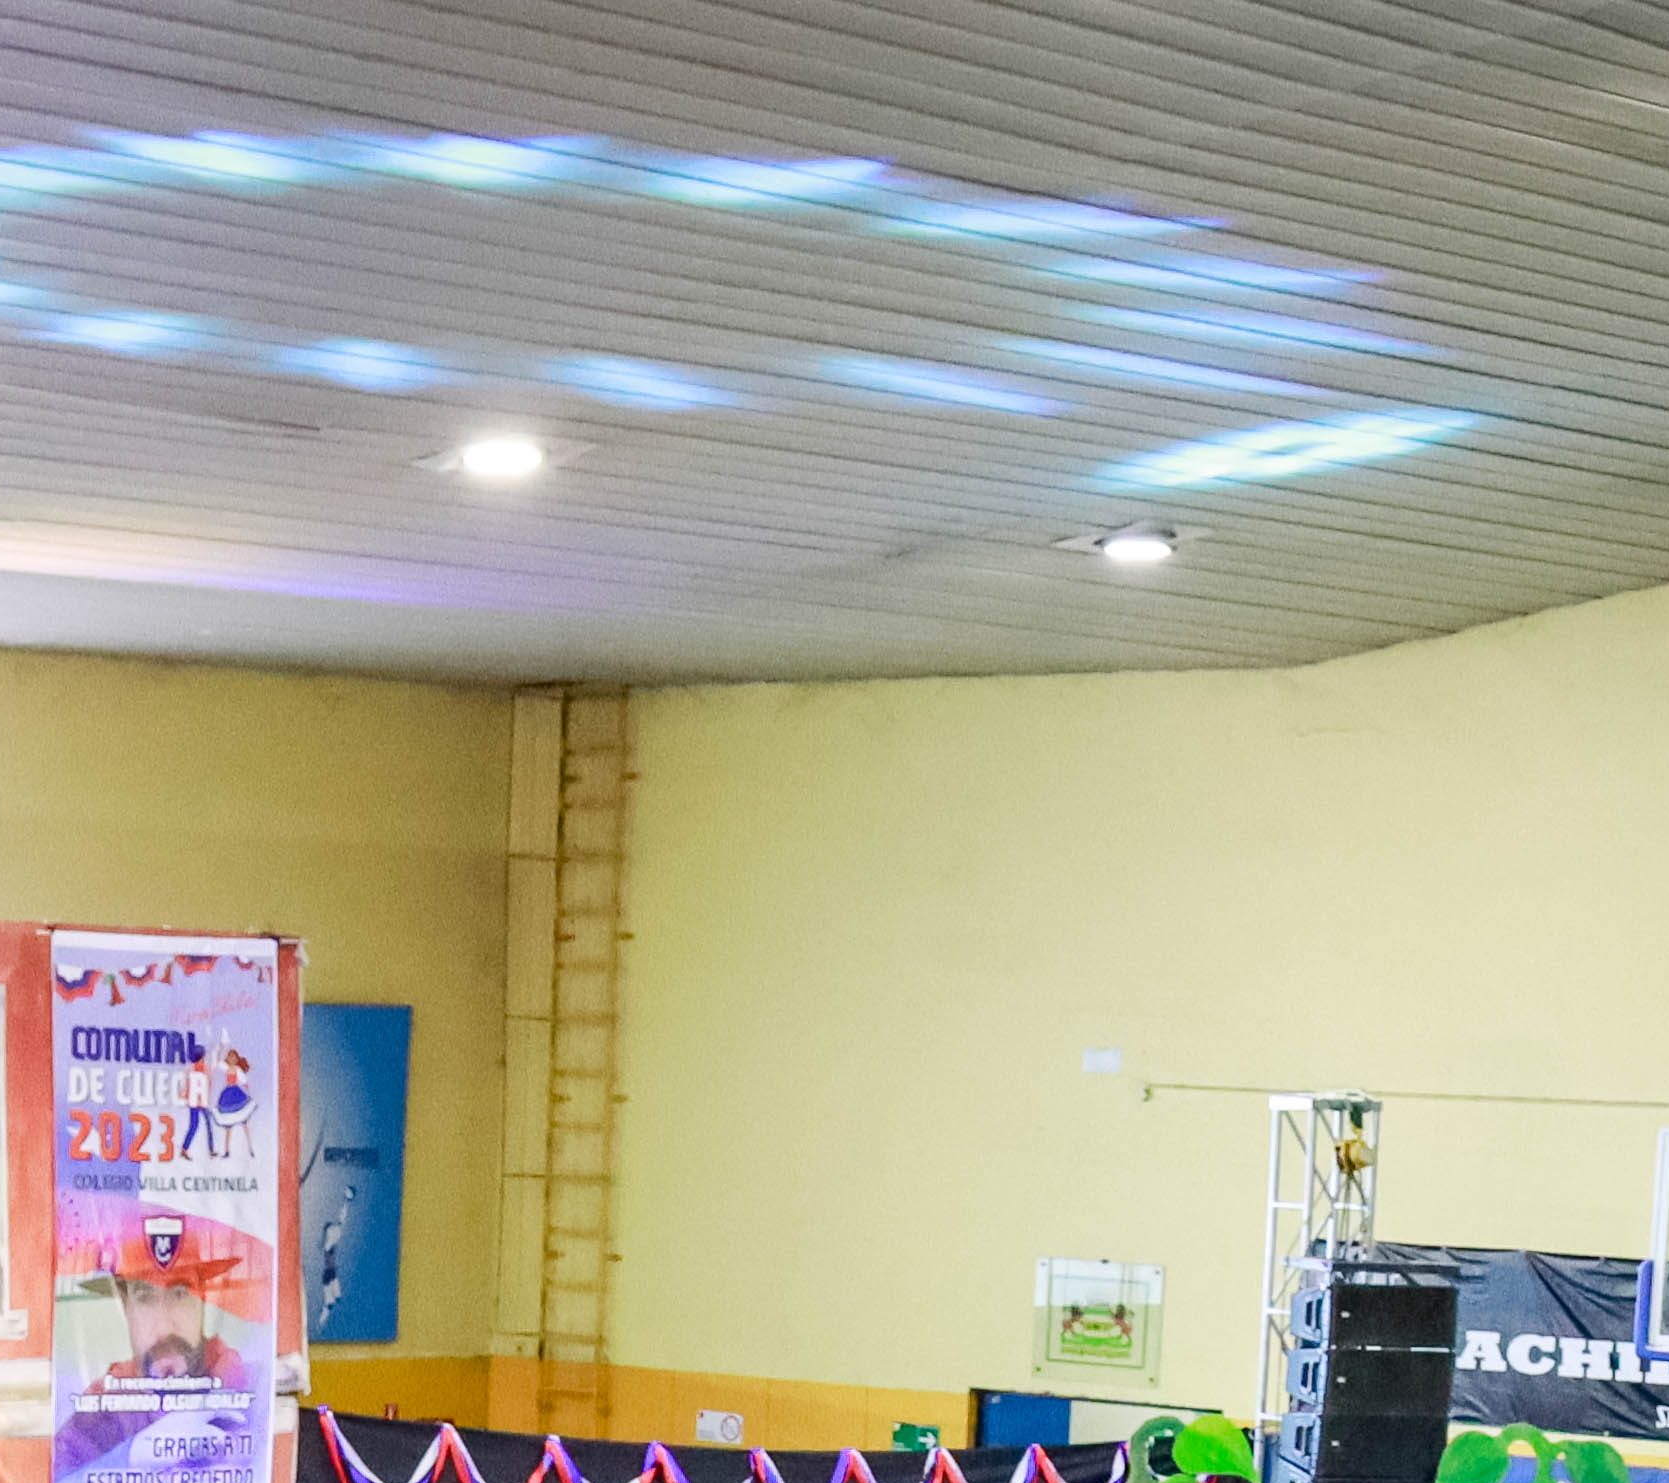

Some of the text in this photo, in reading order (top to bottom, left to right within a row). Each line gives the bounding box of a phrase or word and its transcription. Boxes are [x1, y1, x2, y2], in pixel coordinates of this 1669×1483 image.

[71, 1026, 206, 1064] COMUNAL
[67, 1067, 209, 1108] DE CUECA
[69, 1111, 175, 1162] 2023
[139, 1176, 177, 1191] VILLA
[223, 1435, 234, 1455] A
